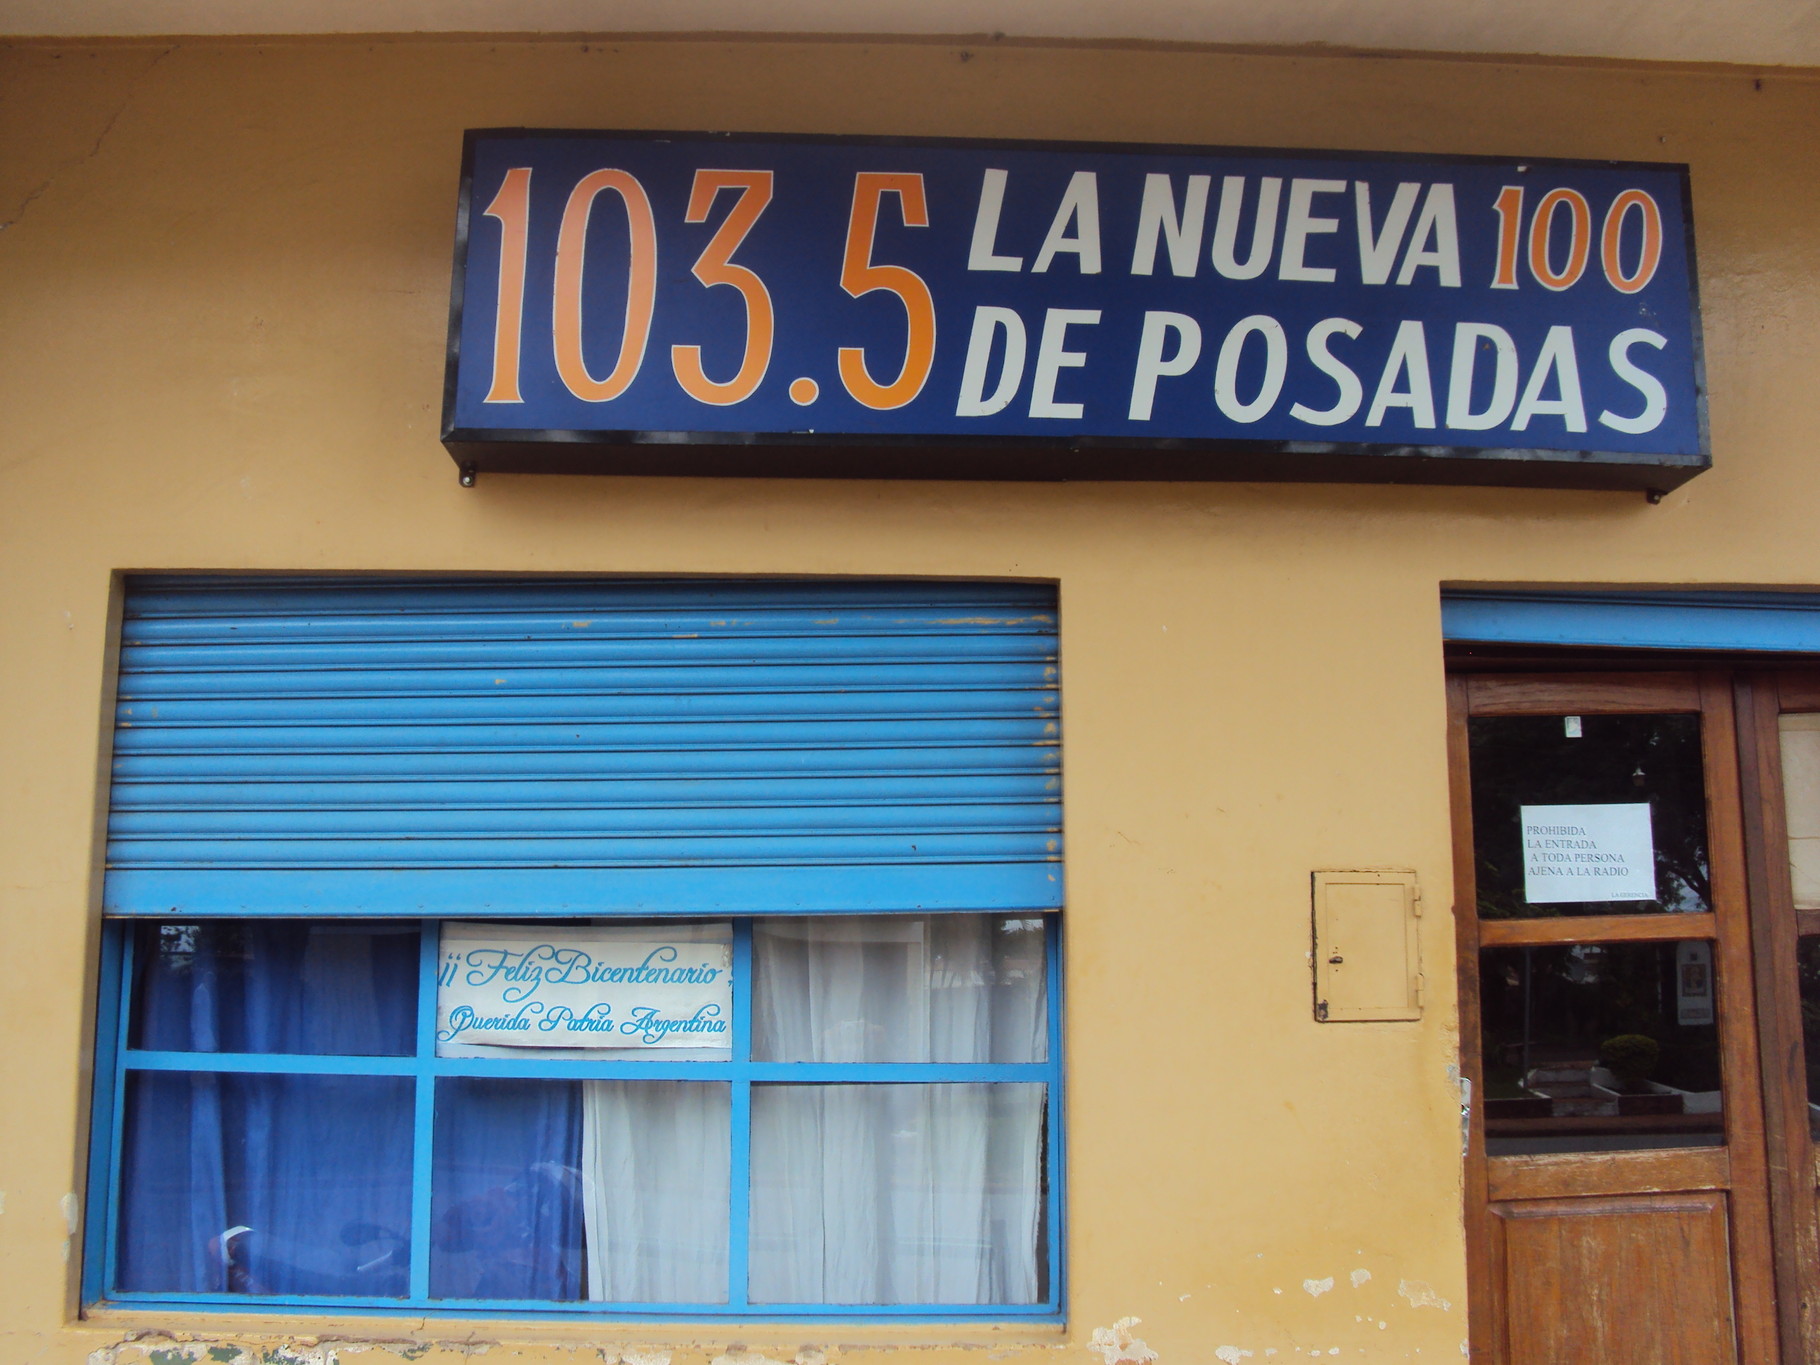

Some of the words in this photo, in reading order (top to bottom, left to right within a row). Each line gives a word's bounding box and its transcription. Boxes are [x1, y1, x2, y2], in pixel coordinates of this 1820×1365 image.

[967, 168, 1102, 275] LA
[1130, 173, 1463, 288] NUEVA
[1490, 185, 1663, 294] 100
[483, 167, 937, 410] 103.5
[955, 305, 1102, 419] DE
[1127, 310, 1669, 435] POSADAS
[1526, 825, 1587, 836] PROHIBIDA
[1526, 839, 1543, 849] LA
[1545, 839, 1598, 850] ENTRADA
[1527, 866, 1564, 876] AJENA
[1566, 867, 1574, 876] A
[1576, 867, 1591, 876] LA
[1594, 867, 1629, 877] RADIO
[1530, 853, 1539, 862] A
[1542, 852, 1572, 863] TODA
[1574, 853, 1625, 863] PERSONA
[545, 946, 723, 986] Bicentenario
[437, 1001, 545, 1042] Querida
[538, 1002, 615, 1033] Patria
[620, 1003, 727, 1044] Argentina
